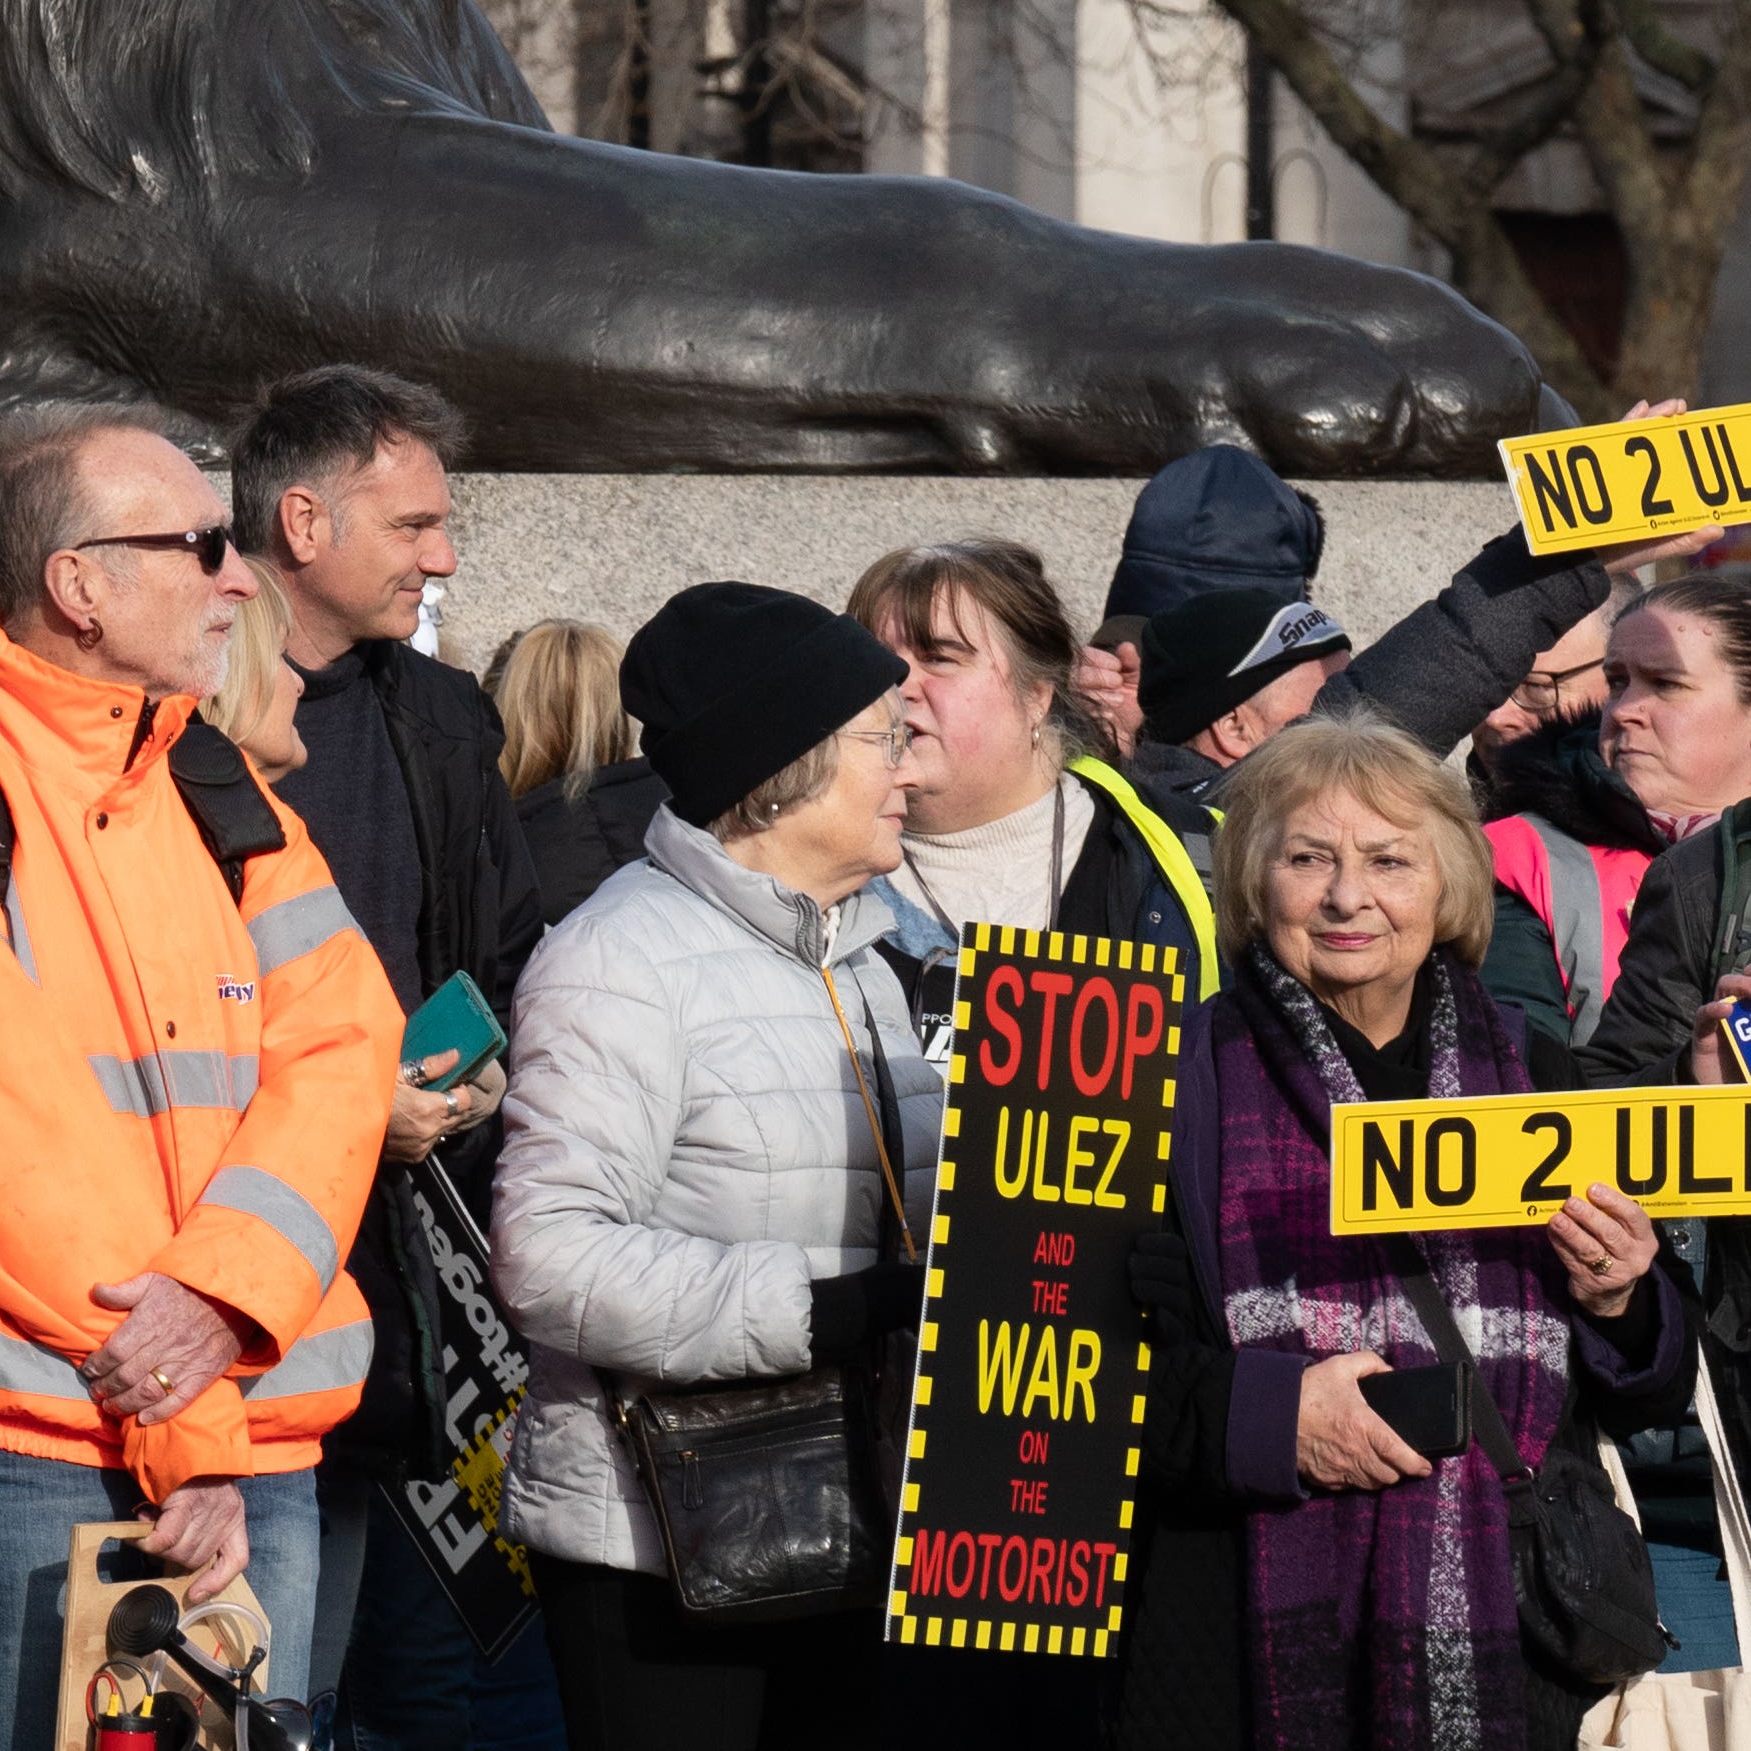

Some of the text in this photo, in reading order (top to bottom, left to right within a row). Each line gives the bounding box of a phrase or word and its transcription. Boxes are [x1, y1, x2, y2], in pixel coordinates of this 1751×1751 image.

[1523, 444, 1613, 533] NO
[1624, 435, 1675, 518] 2
[979, 964, 1165, 1101] STOP
[994, 1105, 1132, 1209] ULEZ
[1361, 1102, 1751, 1212] NO 2 UL
[1033, 1231, 1076, 1267] AND
[1032, 1280, 1069, 1316] THE
[977, 1318, 1102, 1423] WAR
[1019, 1430, 1050, 1466] ON
[1010, 1479, 1049, 1515] THE
[910, 1528, 1117, 1609] MOTORIST
